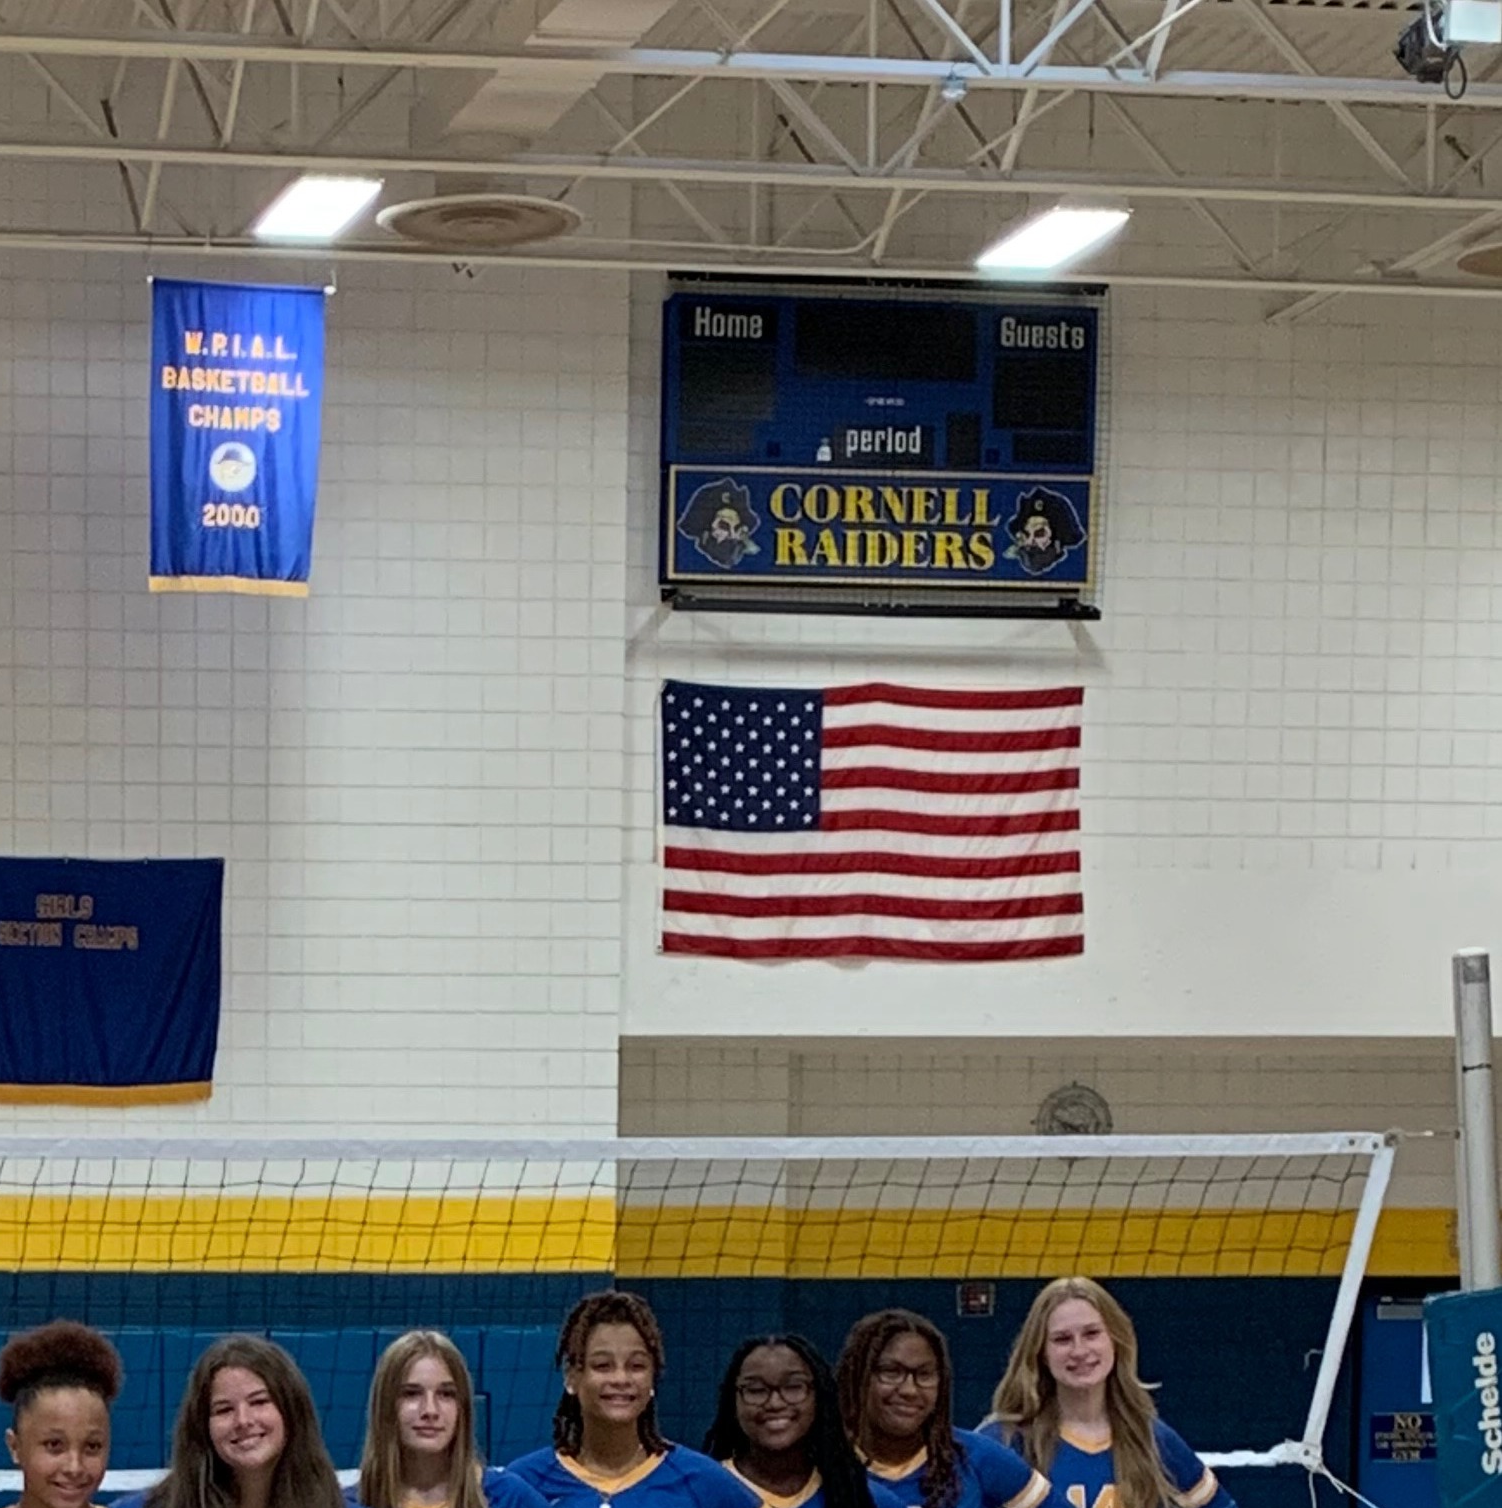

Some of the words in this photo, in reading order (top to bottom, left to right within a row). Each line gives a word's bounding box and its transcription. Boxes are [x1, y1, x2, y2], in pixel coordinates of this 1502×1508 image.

[694, 306, 763, 339] Home
[1000, 317, 1086, 350] Guests
[184, 331, 299, 361] W.P.I.A.L.
[162, 365, 310, 398] BASKETBALL
[188, 403, 282, 433] CHAMPS
[845, 425, 922, 457] period
[202, 503, 261, 529] 2000
[769, 482, 1000, 529] CORNELL
[774, 527, 996, 571] RAIDERS
[1471, 1331, 1502, 1475] Schelde
